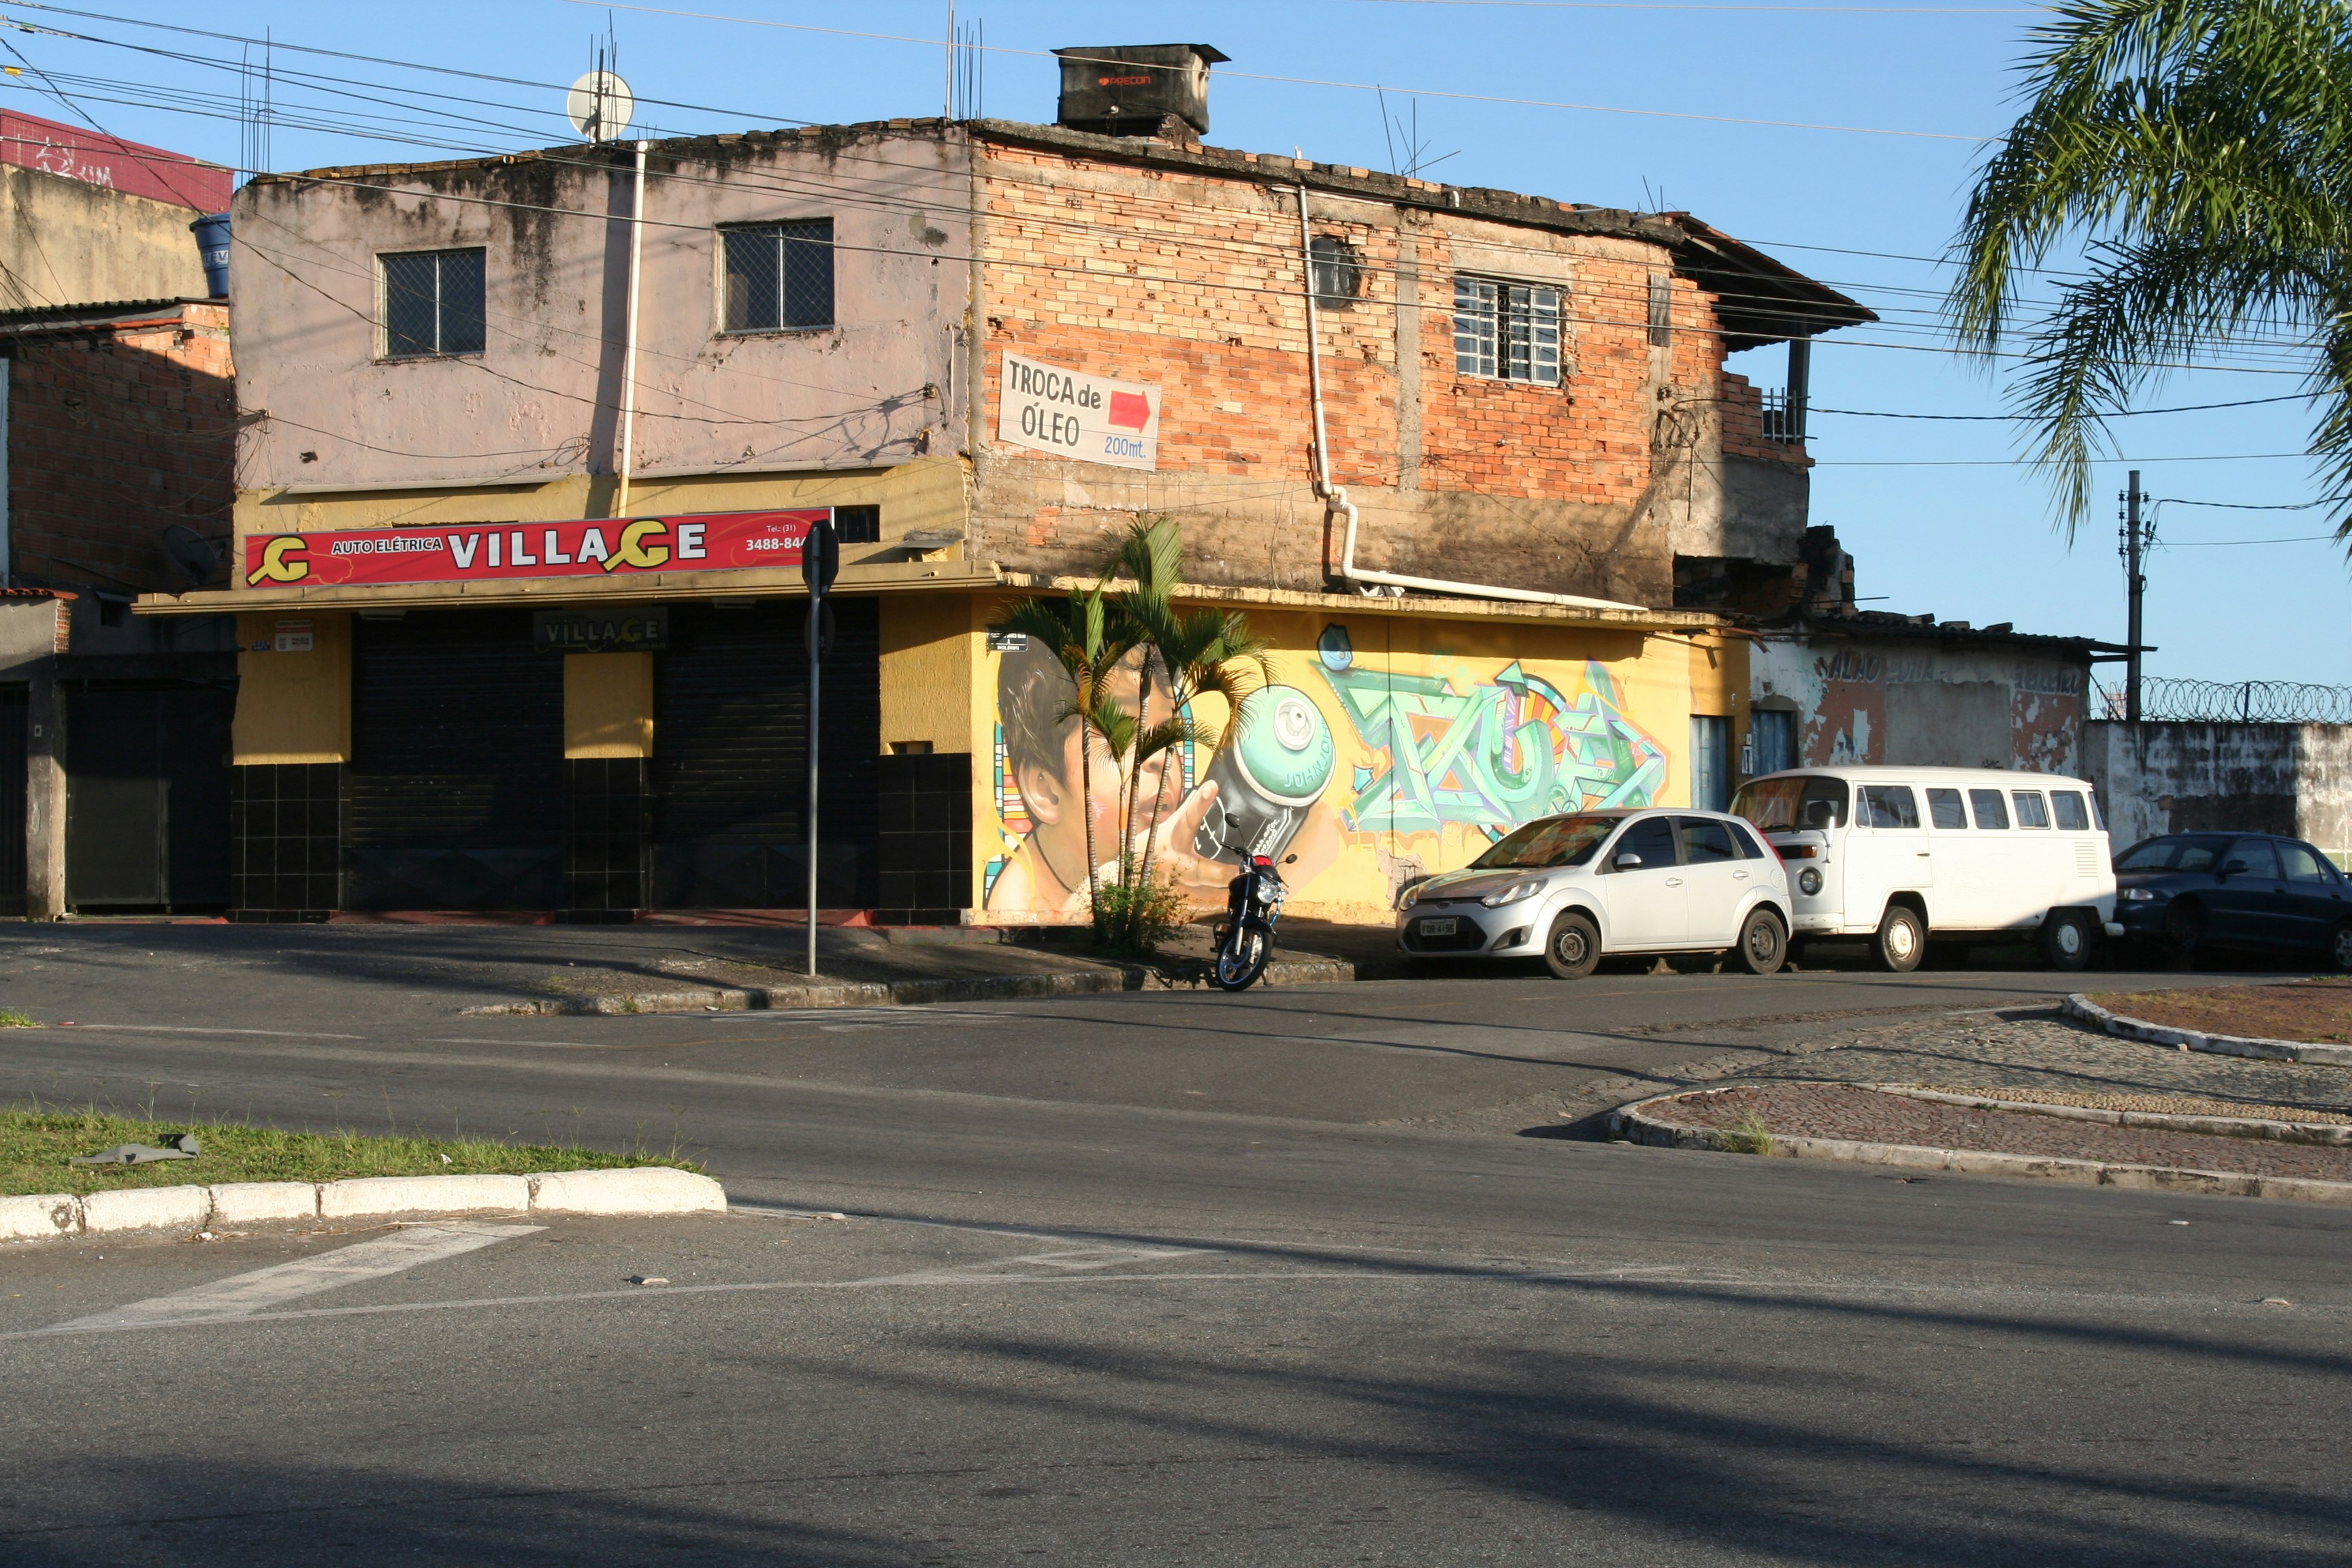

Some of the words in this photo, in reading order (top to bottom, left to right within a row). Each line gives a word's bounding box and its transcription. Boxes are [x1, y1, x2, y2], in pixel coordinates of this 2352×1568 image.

[1009, 359, 1075, 405] TROCA
[1077, 384, 1102, 410] de
[1022, 402, 1080, 447] ÓLEO
[331, 540, 373, 555] AUTO
[375, 536, 443, 554] ELÉTRICA
[446, 519, 708, 572] VILLAGE
[782, 524, 797, 533] (31)
[544, 617, 659, 644] VILLAGE
